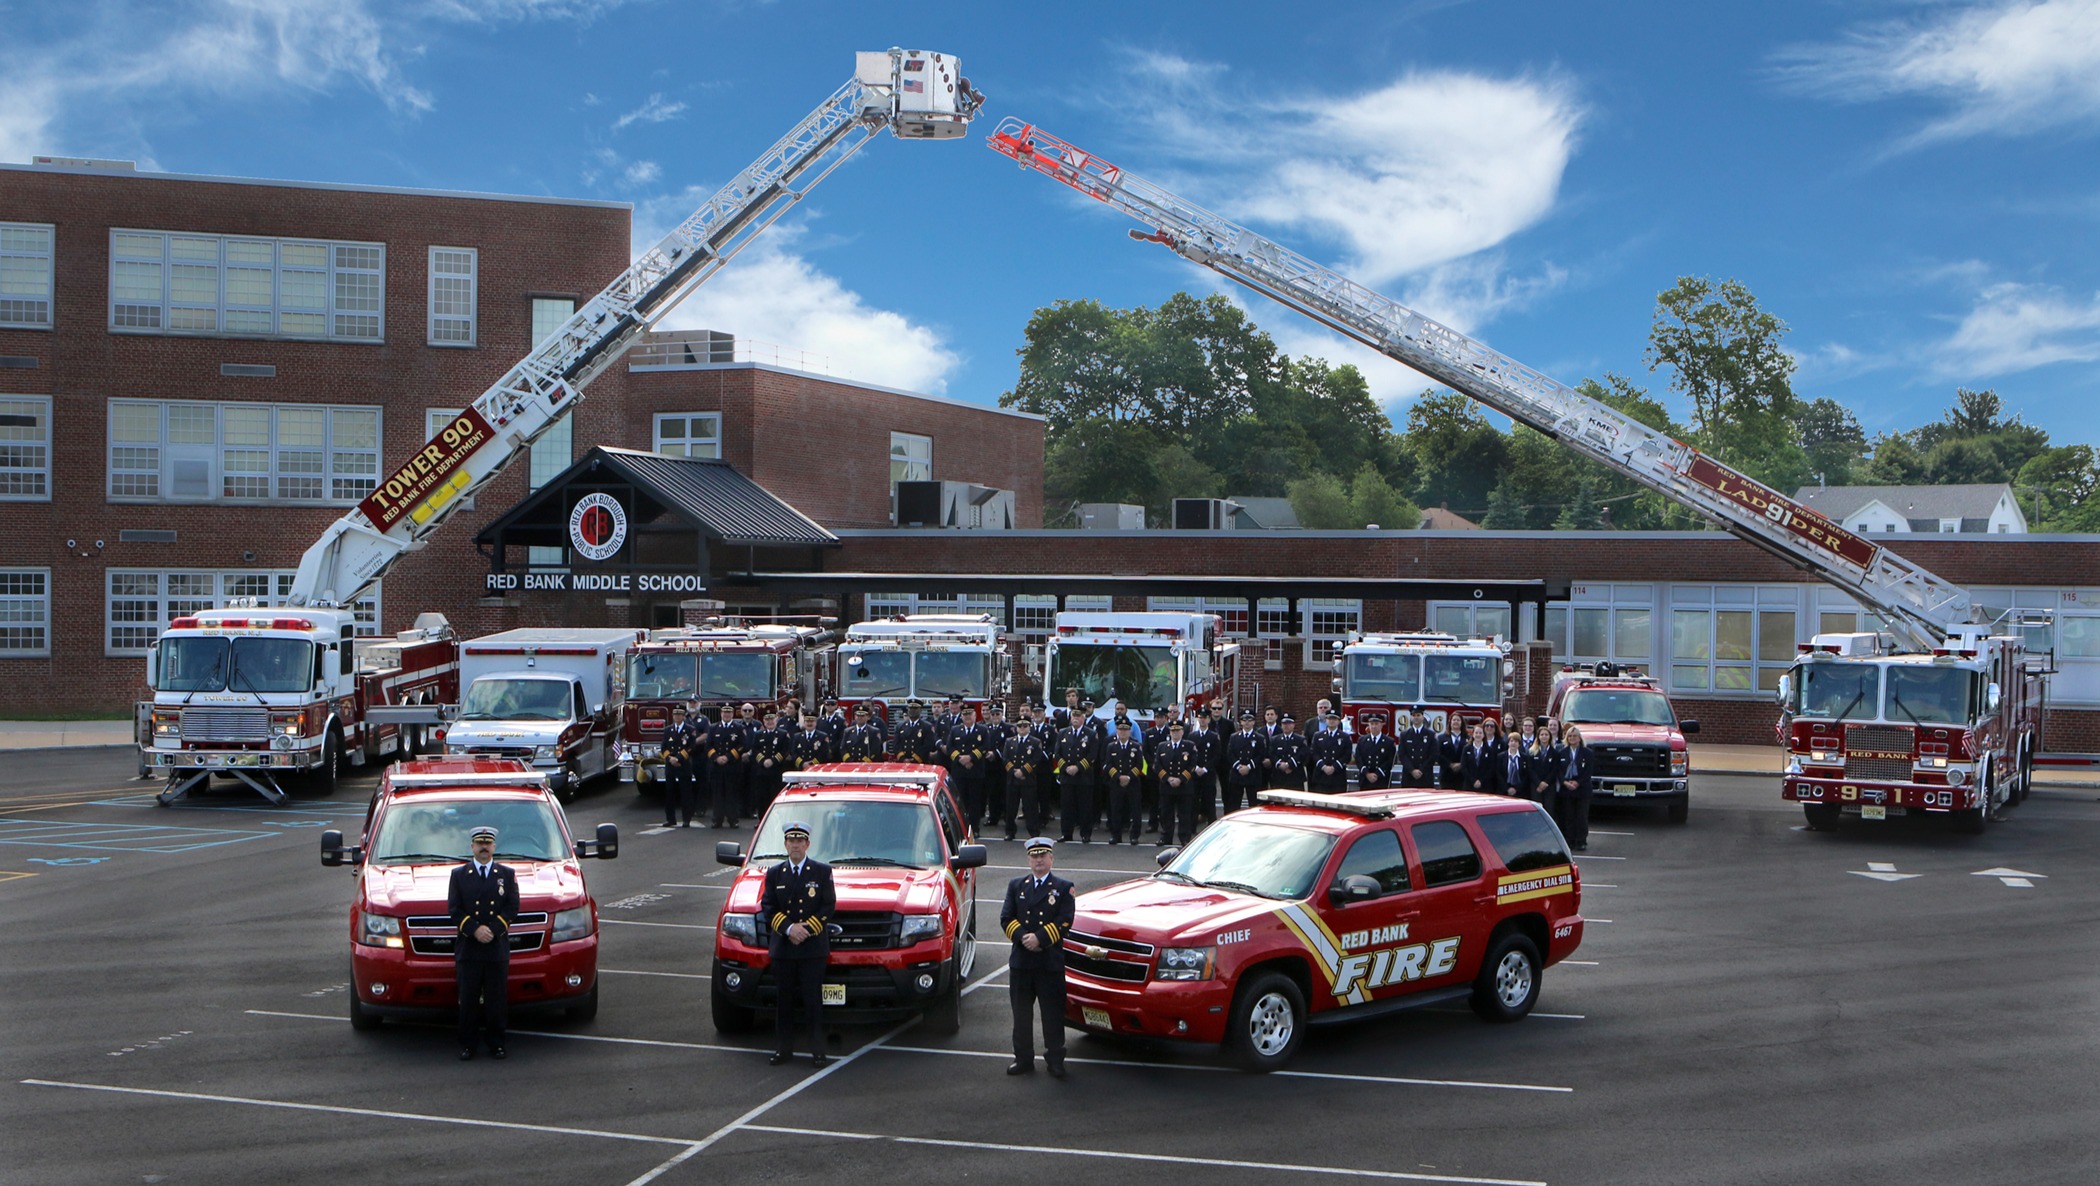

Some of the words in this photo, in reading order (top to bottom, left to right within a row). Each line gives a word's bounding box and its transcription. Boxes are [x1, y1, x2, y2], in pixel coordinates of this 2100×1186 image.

[1588, 417, 1613, 433] KME
[371, 444, 445, 510] TOWER
[442, 417, 474, 449] 90
[382, 507, 400, 523] RED
[398, 488, 420, 509] BANK
[419, 473, 438, 492] FIRE
[437, 429, 485, 475] DEPARTMENT
[571, 509, 581, 526] RED
[578, 494, 598, 511] BANK
[598, 494, 624, 526] BOROUGH
[1717, 467, 1736, 480] RED
[1740, 479, 1766, 496] BANK
[1769, 493, 1791, 508] FIRE
[1794, 507, 1855, 541] DEPARTMENT
[1764, 502, 1793, 527] 91
[572, 531, 593, 557] PUBLIC
[595, 532, 624, 559] SCHOOLS
[486, 574, 517, 589] RED
[524, 575, 565, 590] BANK
[572, 575, 631, 590] MIDDLE
[638, 575, 707, 592] SCHOOL
[1574, 586, 1586, 594] 114
[2063, 592, 2077, 601] 115
[1878, 752, 1909, 760] BANK
[1504, 879, 1542, 895] EMERGENCY
[1543, 876, 1558, 887] DIAL
[1558, 875, 1568, 885] 911
[1216, 928, 1251, 946] CHIEF
[1341, 930, 1369, 950] RED
[1371, 923, 1410, 945] BANK
[1554, 926, 1573, 939] 6467
[1330, 935, 1461, 996] FIRE
